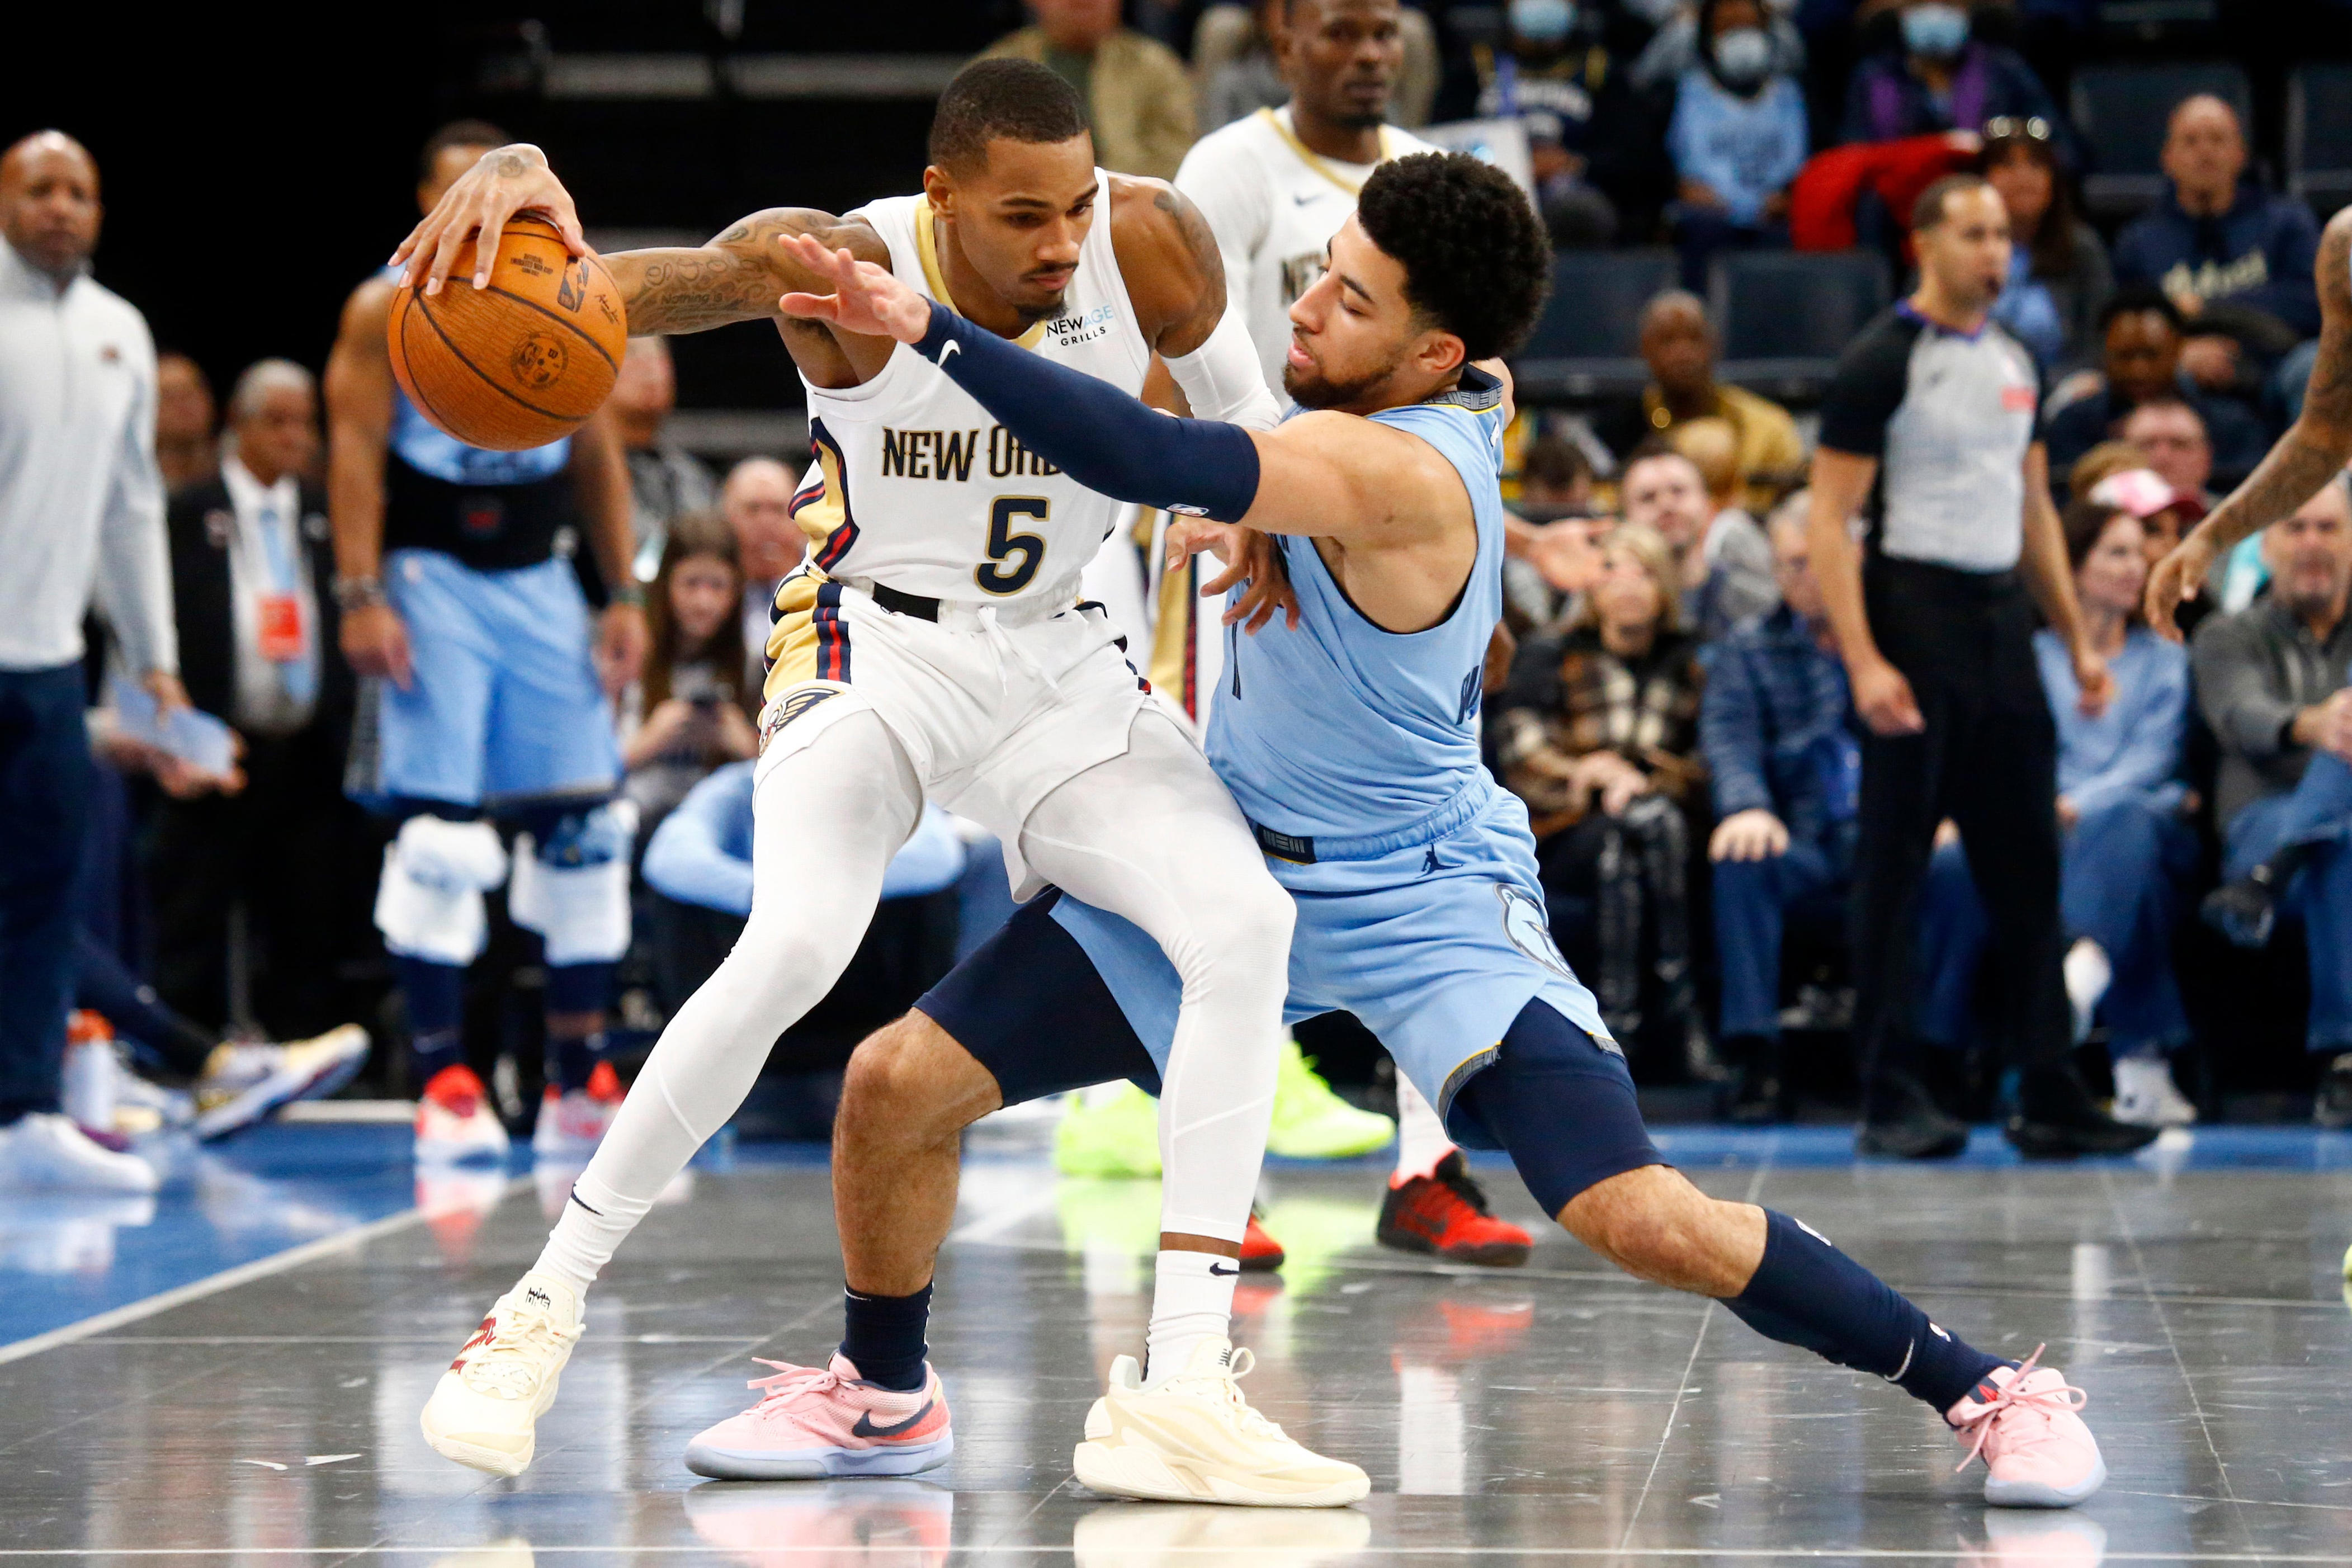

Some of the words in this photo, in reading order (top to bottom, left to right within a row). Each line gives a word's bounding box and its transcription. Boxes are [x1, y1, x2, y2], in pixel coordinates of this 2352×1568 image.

[1061, 326, 1106, 346] GRILLS
[882, 426, 980, 481] NEW
[974, 494, 1051, 597] 5
